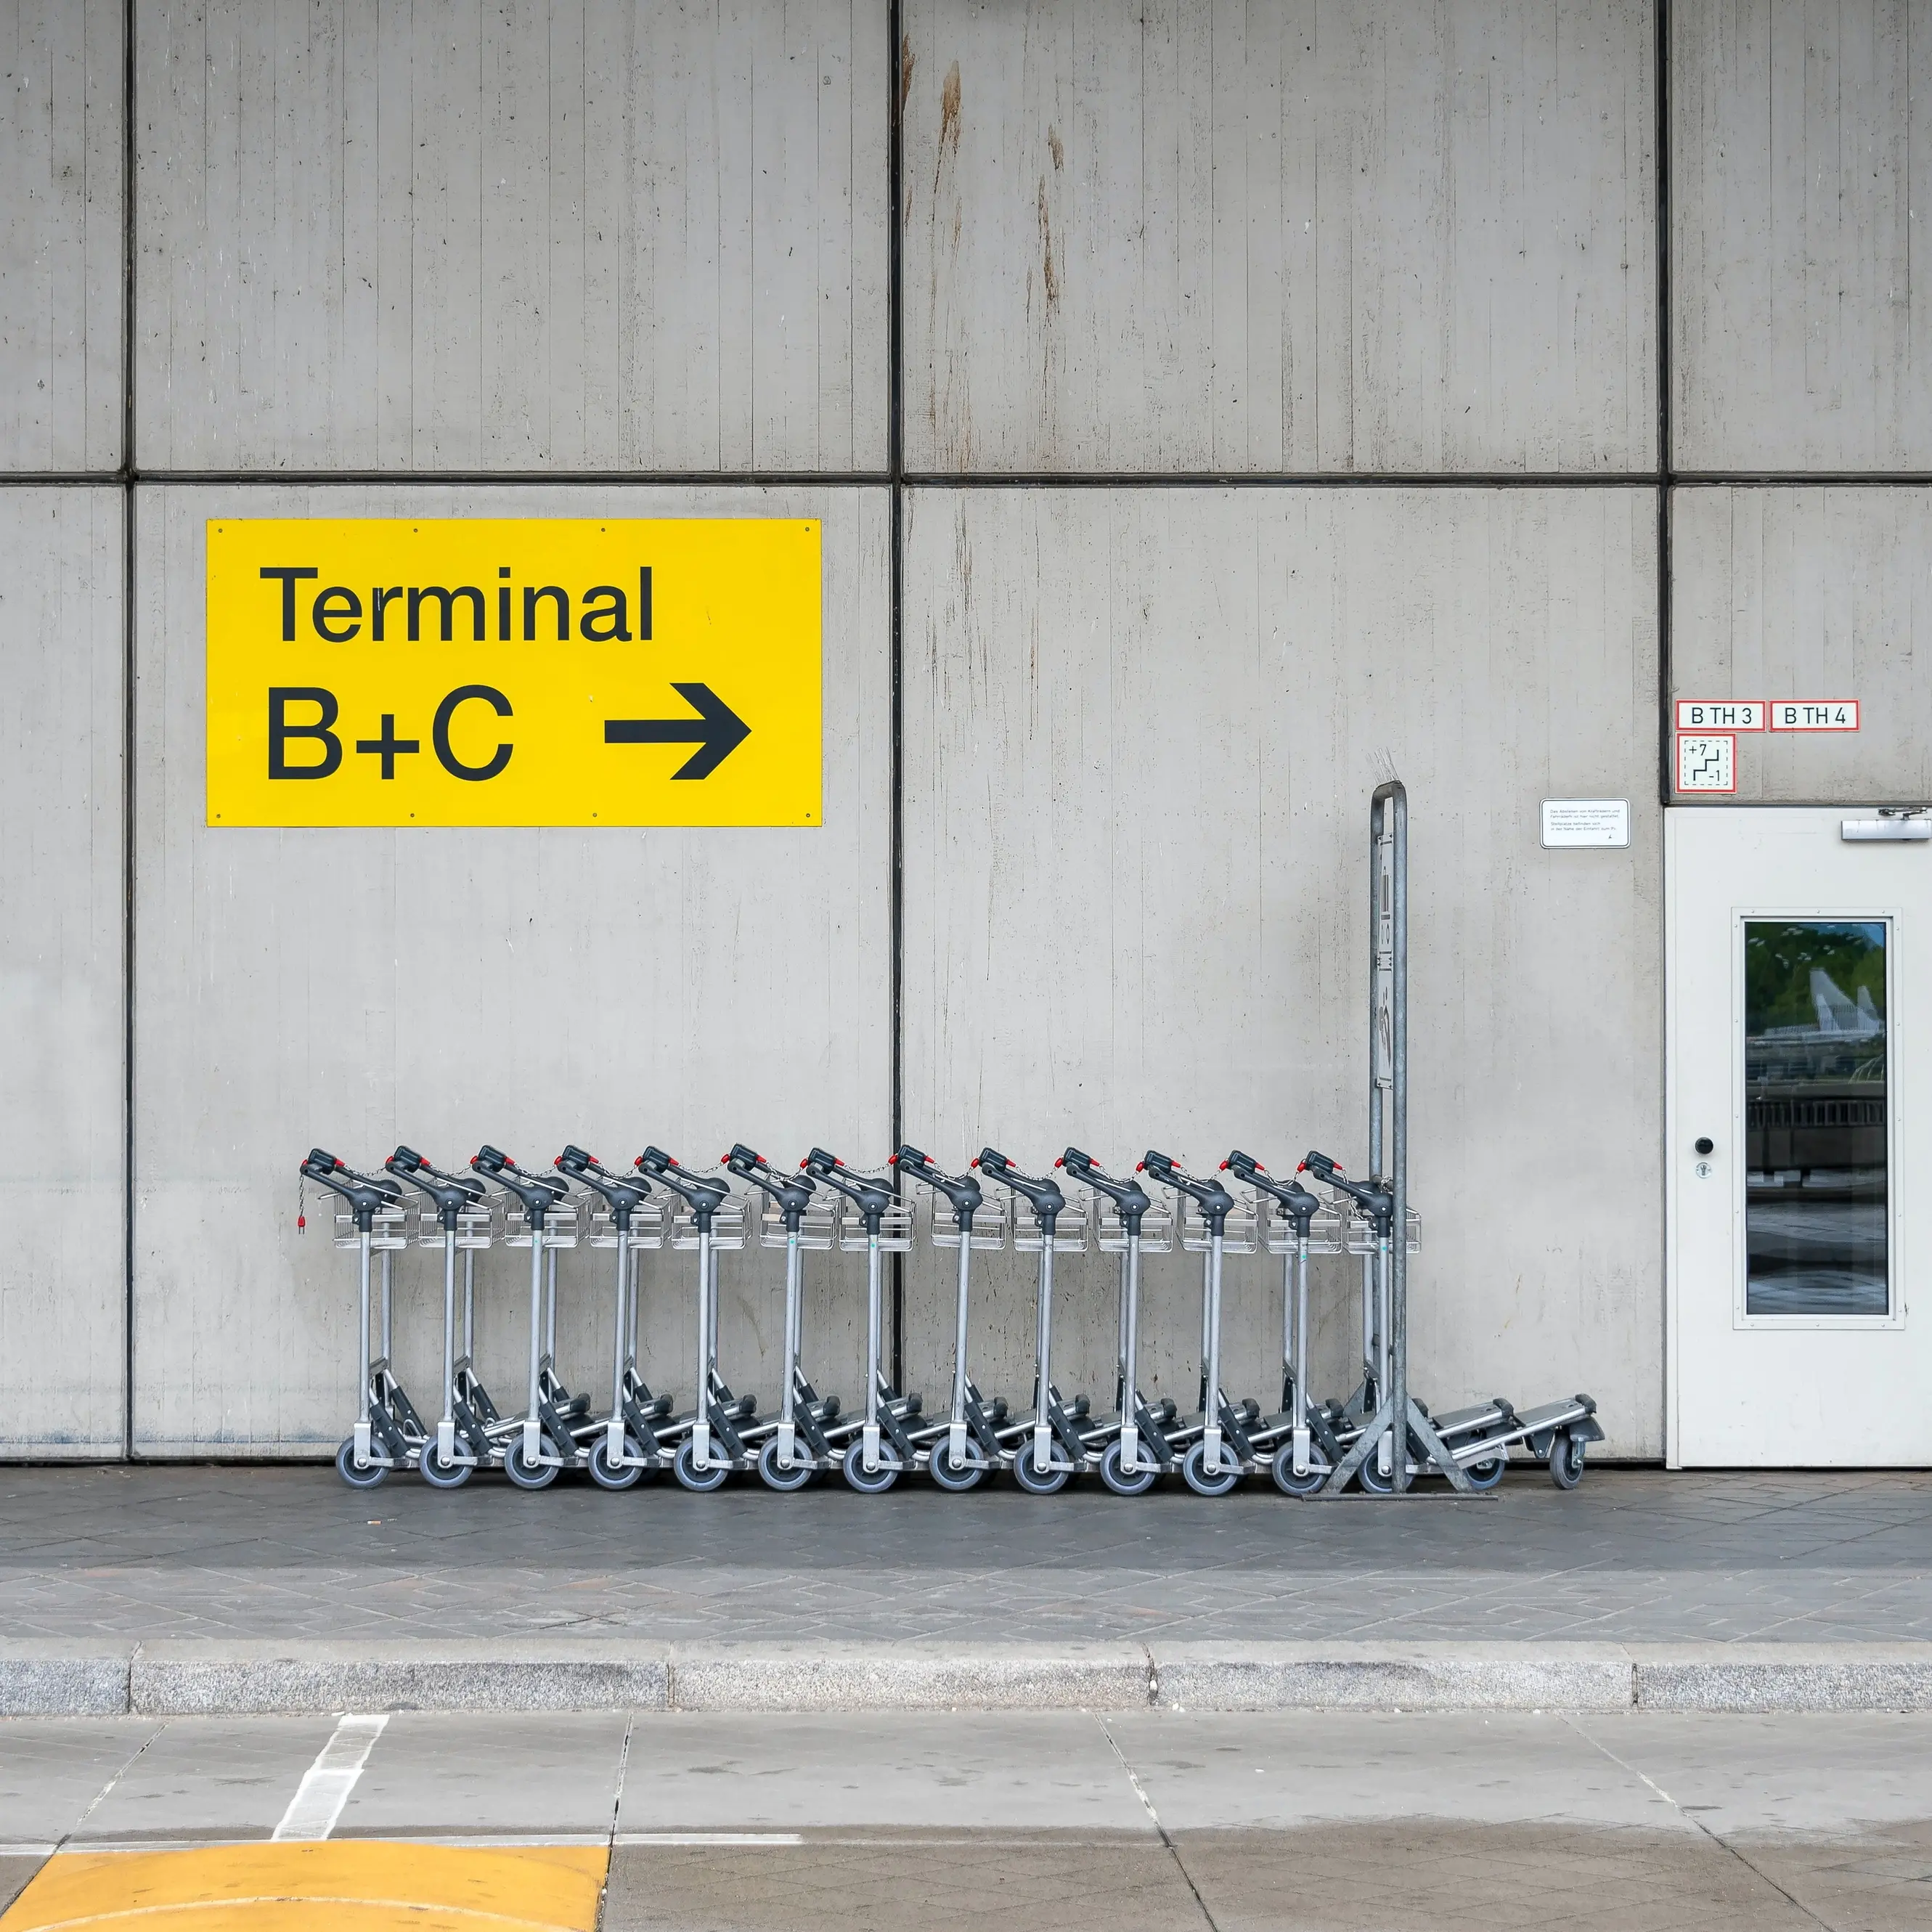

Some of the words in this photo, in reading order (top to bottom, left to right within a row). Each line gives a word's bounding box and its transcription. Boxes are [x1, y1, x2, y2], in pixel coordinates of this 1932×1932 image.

[259, 566, 653, 643] Terminal
[268, 684, 514, 782] B+C
[1691, 706, 1704, 725] B
[1709, 707, 1735, 725] TH
[1742, 707, 1753, 725] 3
[1785, 706, 1798, 725] B
[1802, 706, 1829, 725] TH
[1835, 706, 1846, 725] 4
